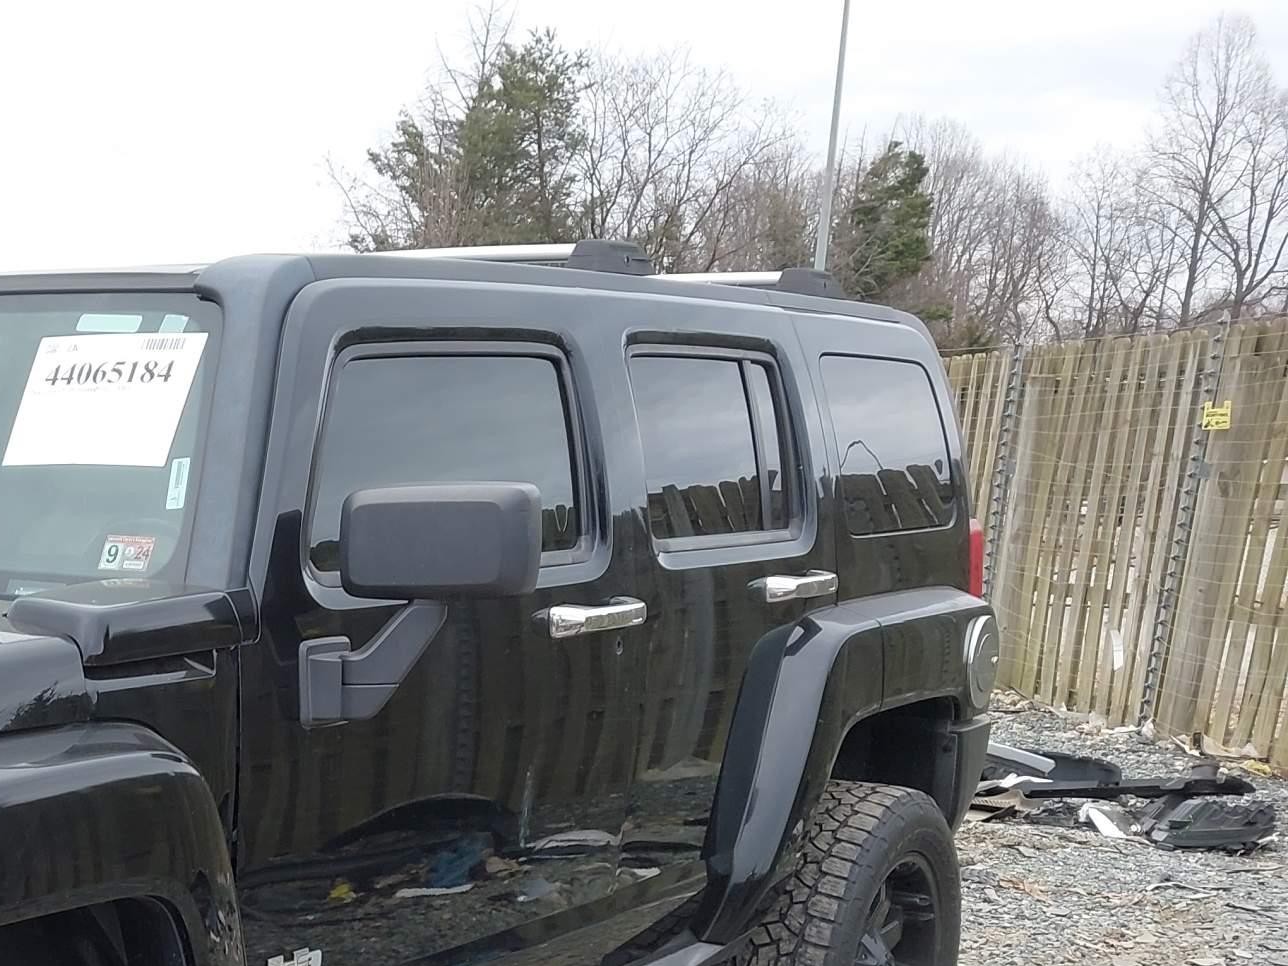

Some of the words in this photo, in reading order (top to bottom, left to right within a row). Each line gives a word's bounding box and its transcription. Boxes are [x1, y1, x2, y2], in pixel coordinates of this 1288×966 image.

[45, 360, 175, 386] 44065184
[105, 544, 119, 564] 9
[134, 545, 151, 562] 24
